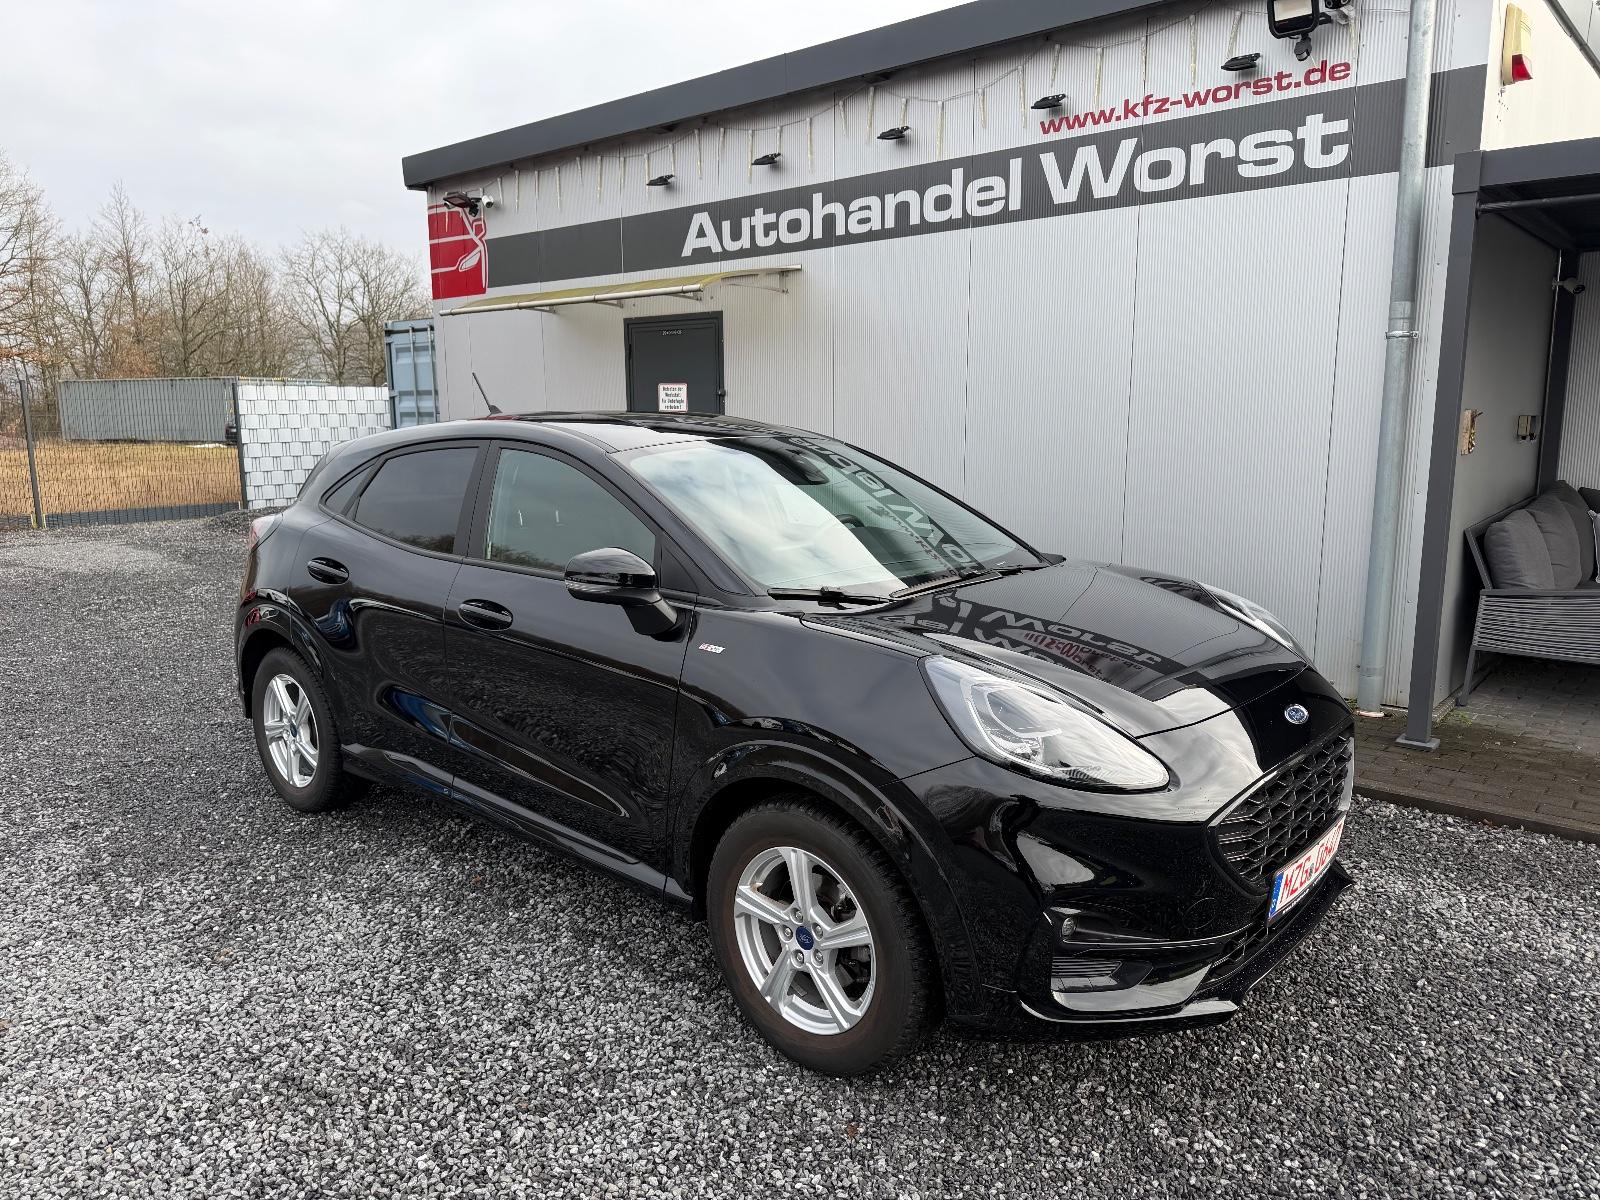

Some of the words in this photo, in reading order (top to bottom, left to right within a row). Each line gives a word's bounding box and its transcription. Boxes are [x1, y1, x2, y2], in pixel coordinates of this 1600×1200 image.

[1041, 60, 1351, 134] www.kfz-worst.de
[681, 157, 1022, 257] Autohandel
[1040, 112, 1350, 206] Worst
